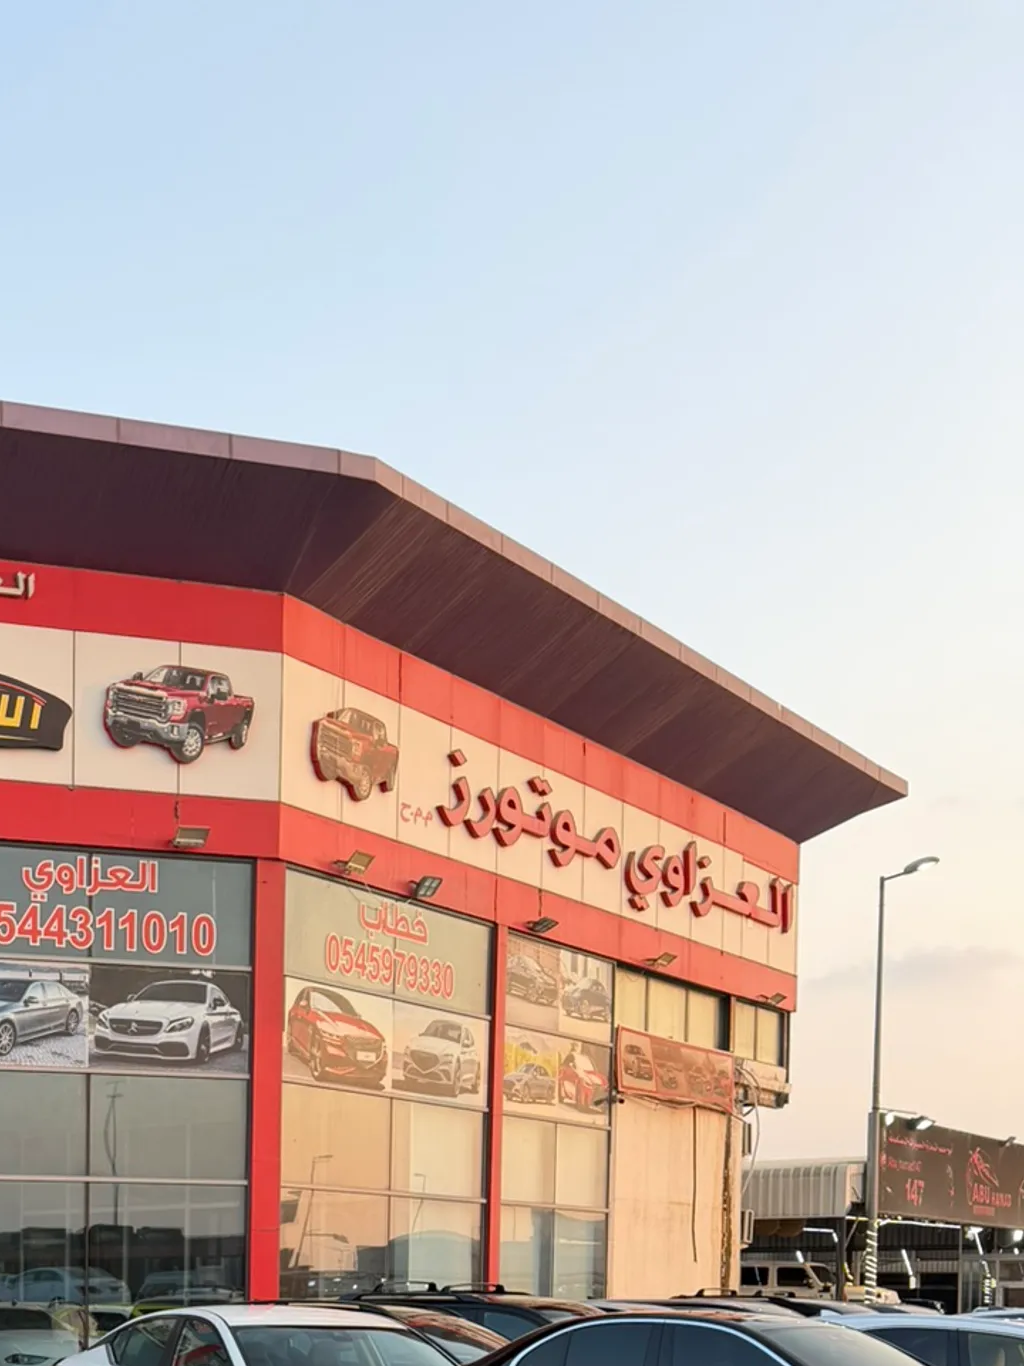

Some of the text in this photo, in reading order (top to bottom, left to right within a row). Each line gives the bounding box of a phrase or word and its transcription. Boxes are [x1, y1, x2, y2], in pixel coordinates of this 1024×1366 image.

[435, 748, 794, 934] العزاوي موتورز
[21, 855, 159, 903] العزاوي
[359, 898, 429, 946] خطاب
[325, 931, 455, 1001] 0545979330
[904, 1177, 925, 1206] 147
